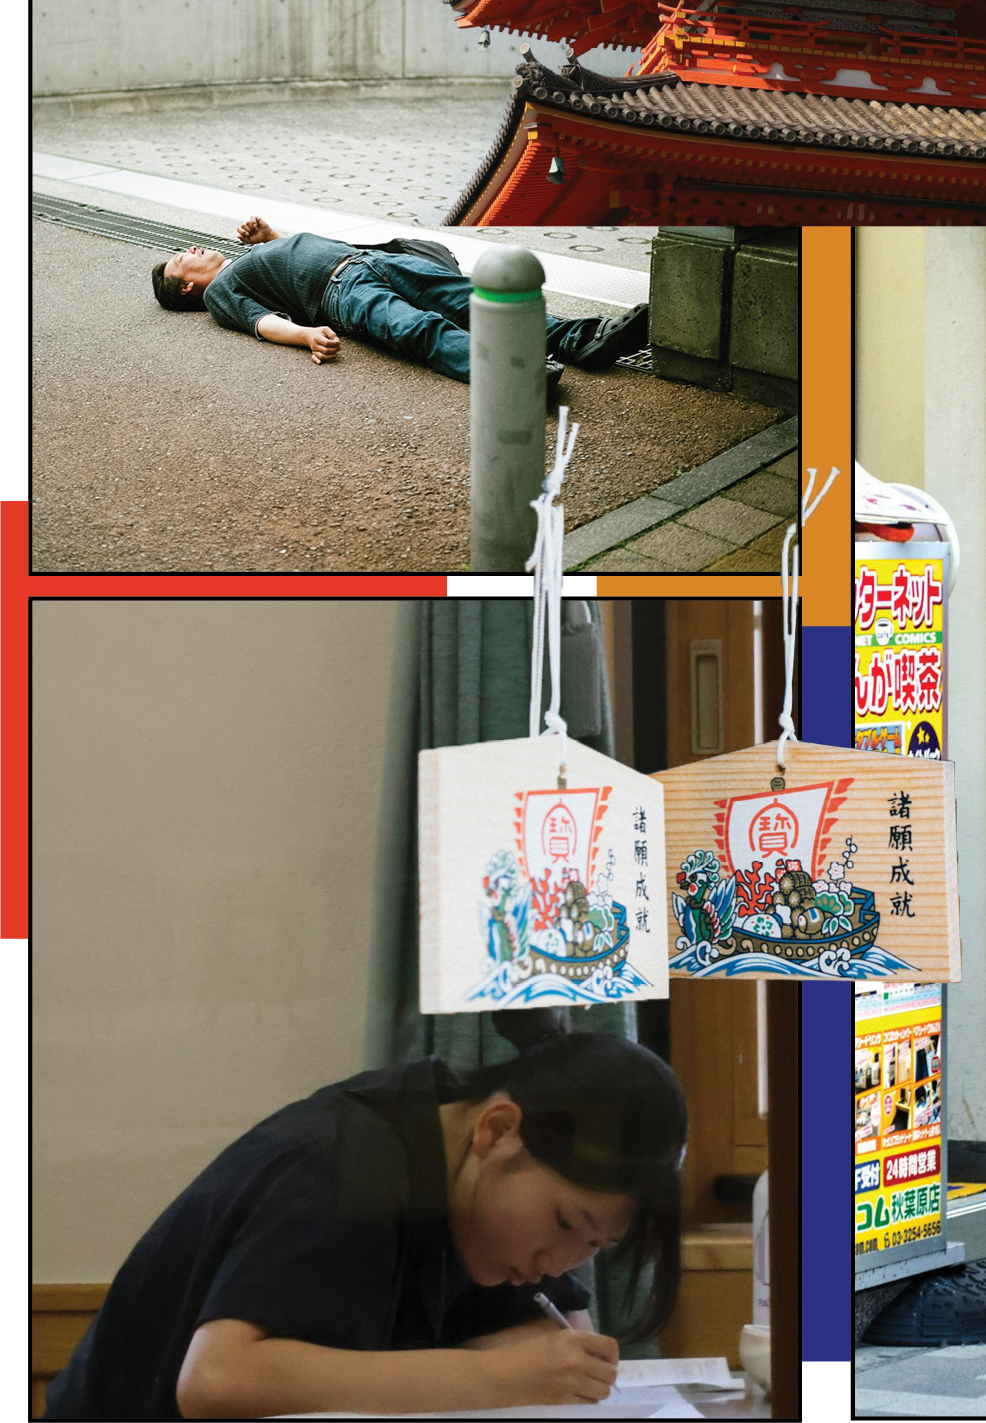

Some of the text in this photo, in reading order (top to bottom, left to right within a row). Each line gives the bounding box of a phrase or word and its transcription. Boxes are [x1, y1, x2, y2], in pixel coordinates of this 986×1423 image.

[855, 563, 943, 631] ターネット
[895, 632, 937, 645] COMICS
[632, 806, 651, 935] 諸願成就
[887, 789, 916, 919] 諸願成就
[886, 1149, 937, 1181] 24時間営業
[891, 1183, 941, 1224] 秋葉原店
[892, 1220, 942, 1246] 03-3254-5656
